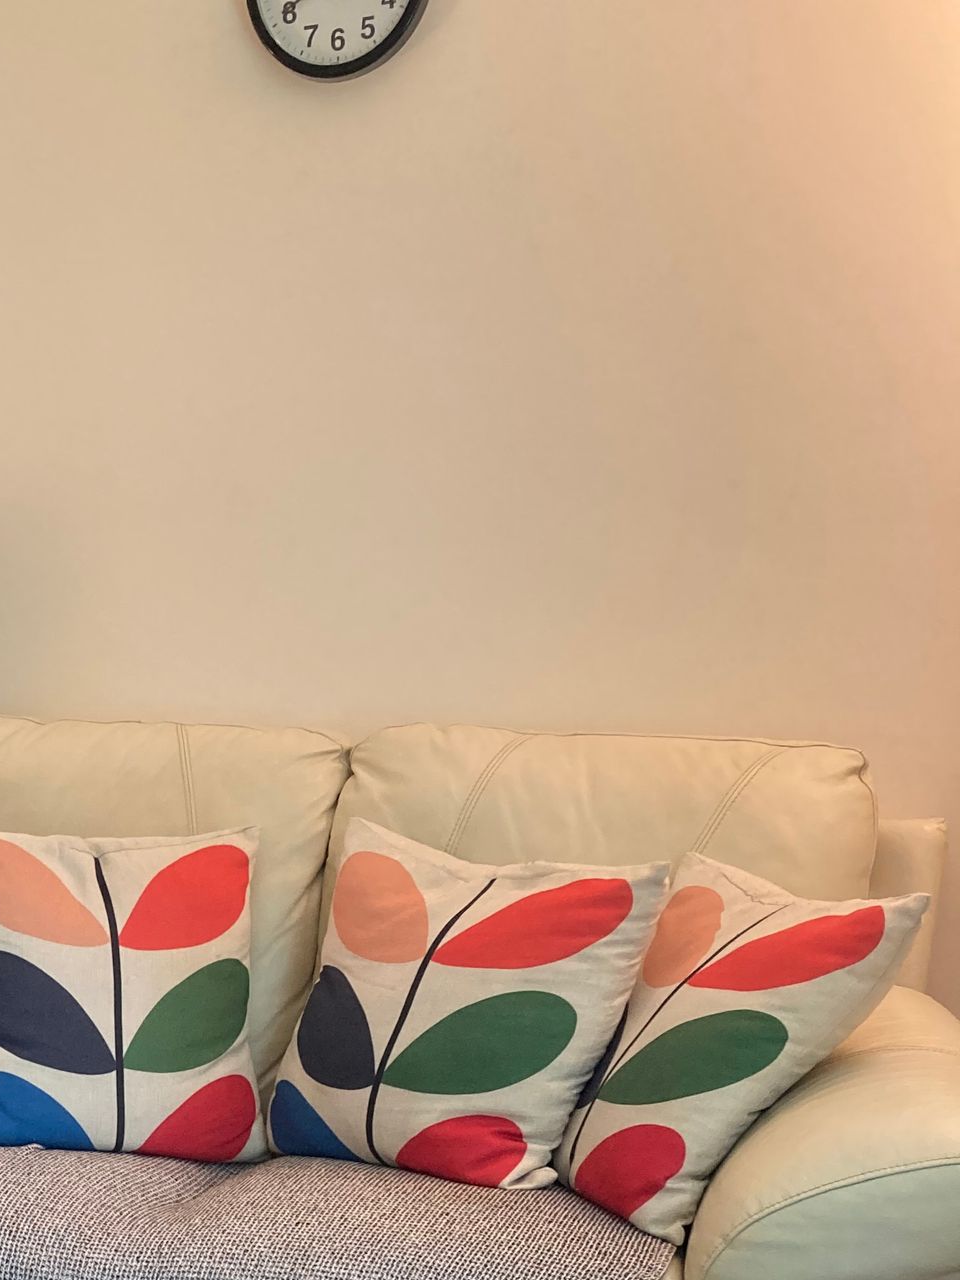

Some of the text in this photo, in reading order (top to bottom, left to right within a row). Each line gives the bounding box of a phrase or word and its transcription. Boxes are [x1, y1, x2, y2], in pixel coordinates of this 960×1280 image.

[282, 1, 297, 24] 8
[303, 24, 319, 48] 7
[330, 27, 345, 51] 6
[360, 15, 376, 39] 5
